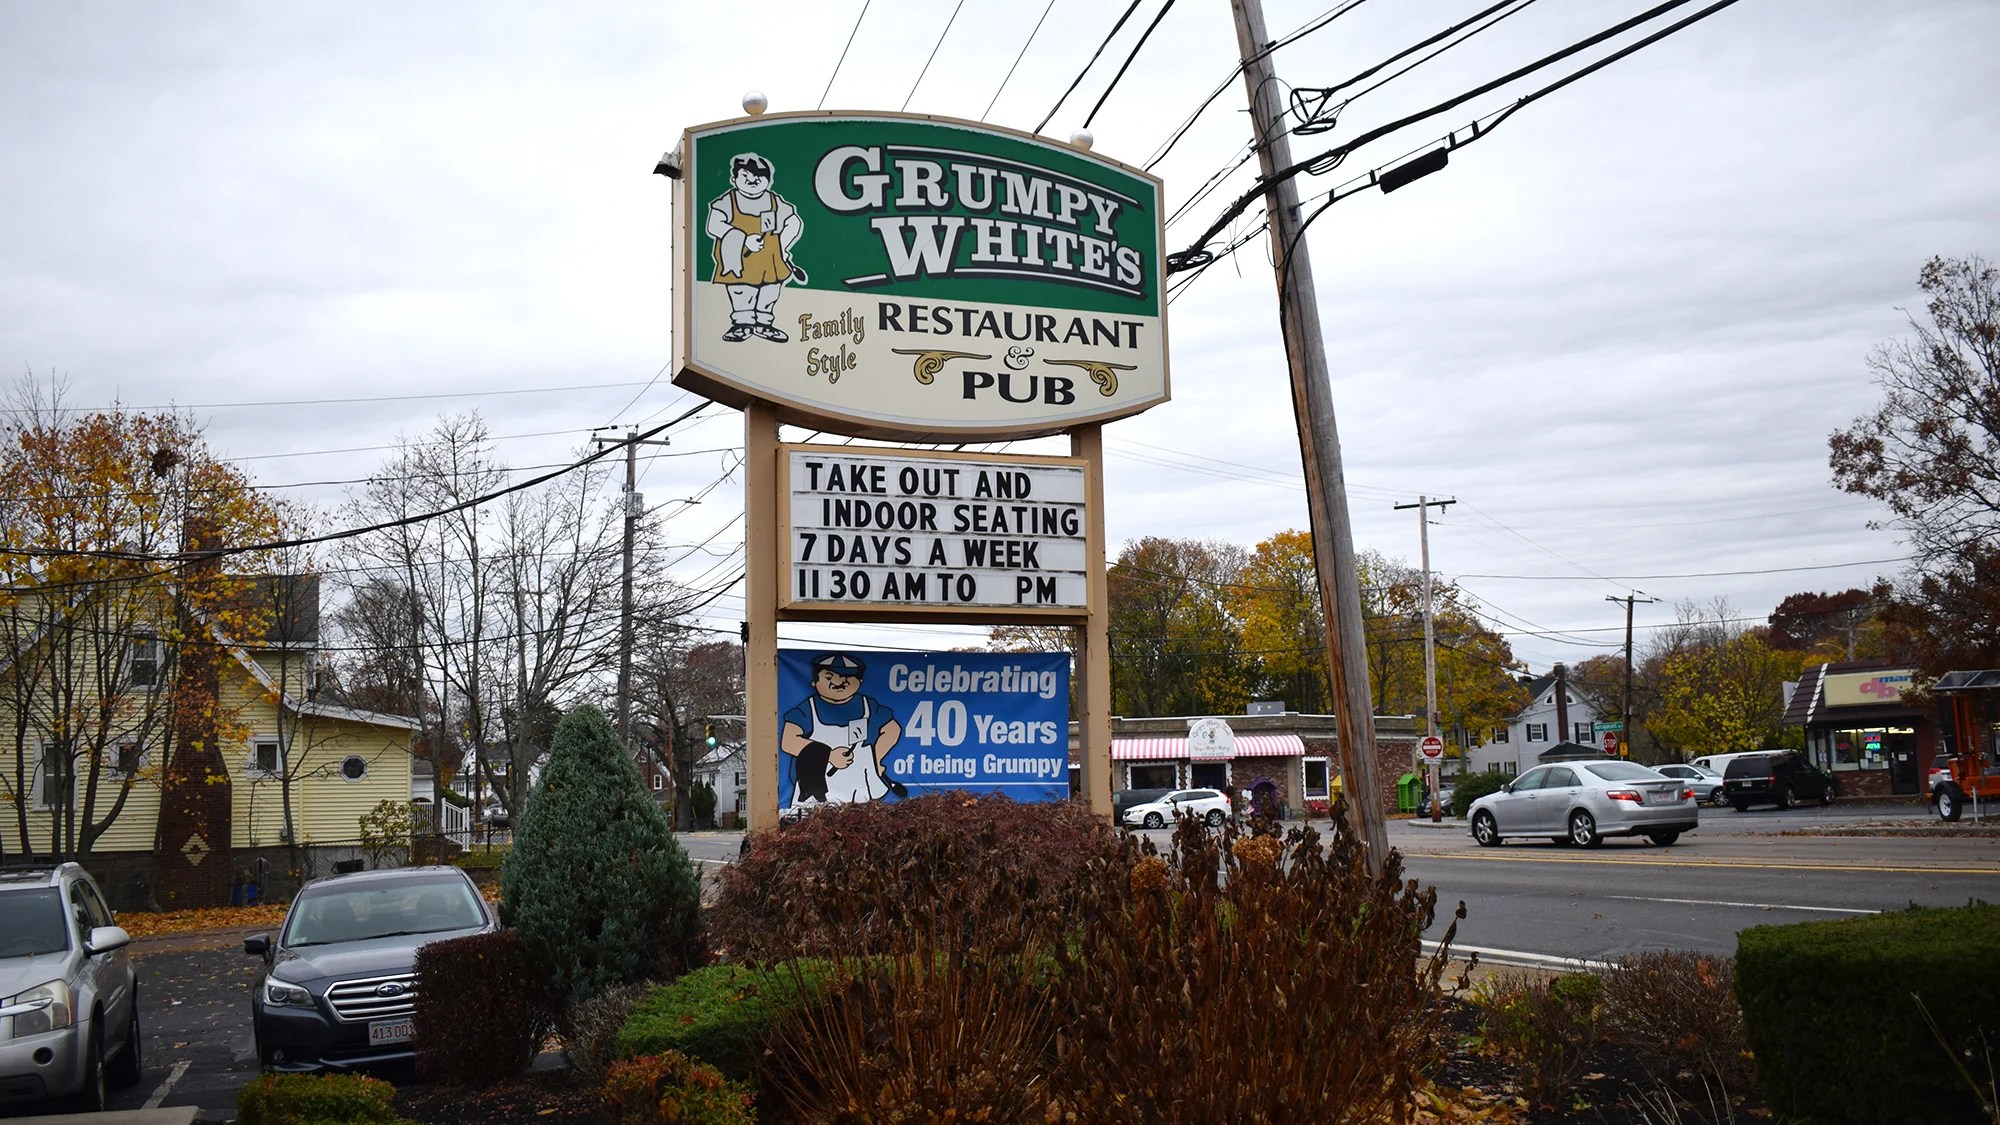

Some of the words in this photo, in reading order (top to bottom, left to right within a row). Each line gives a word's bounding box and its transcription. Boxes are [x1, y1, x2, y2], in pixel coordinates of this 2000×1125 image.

[814, 145, 1121, 237] GRUMPY
[871, 215, 1144, 287] WHITE'S
[798, 307, 866, 345] Family
[878, 302, 1144, 350] RESTAURANT
[806, 343, 857, 384] Style
[1003, 345, 1035, 371] &
[962, 371, 1076, 405] PUB
[805, 462, 887, 493] TAKE
[899, 466, 960, 496] OUT
[975, 470, 1032, 499] AND
[823, 499, 938, 531] INDOOR
[953, 504, 1079, 536] SEATING
[800, 533, 818, 562] 7
[827, 534, 912, 565] DAYS
[928, 538, 948, 566] A
[963, 539, 1041, 569] WEEK
[881, 571, 927, 601] AM
[937, 573, 977, 602] TO
[1016, 576, 1057, 604] PM
[889, 663, 1057, 699] Celebrating
[905, 700, 968, 747] 40
[973, 714, 1058, 744] Years
[1604, 739, 1616, 748] STOP
[1866, 742, 1881, 750] ATM
[893, 753, 915, 775] of
[920, 754, 977, 779] being
[983, 753, 1063, 778] Grumpy
[372, 1027, 392, 1040] 413
